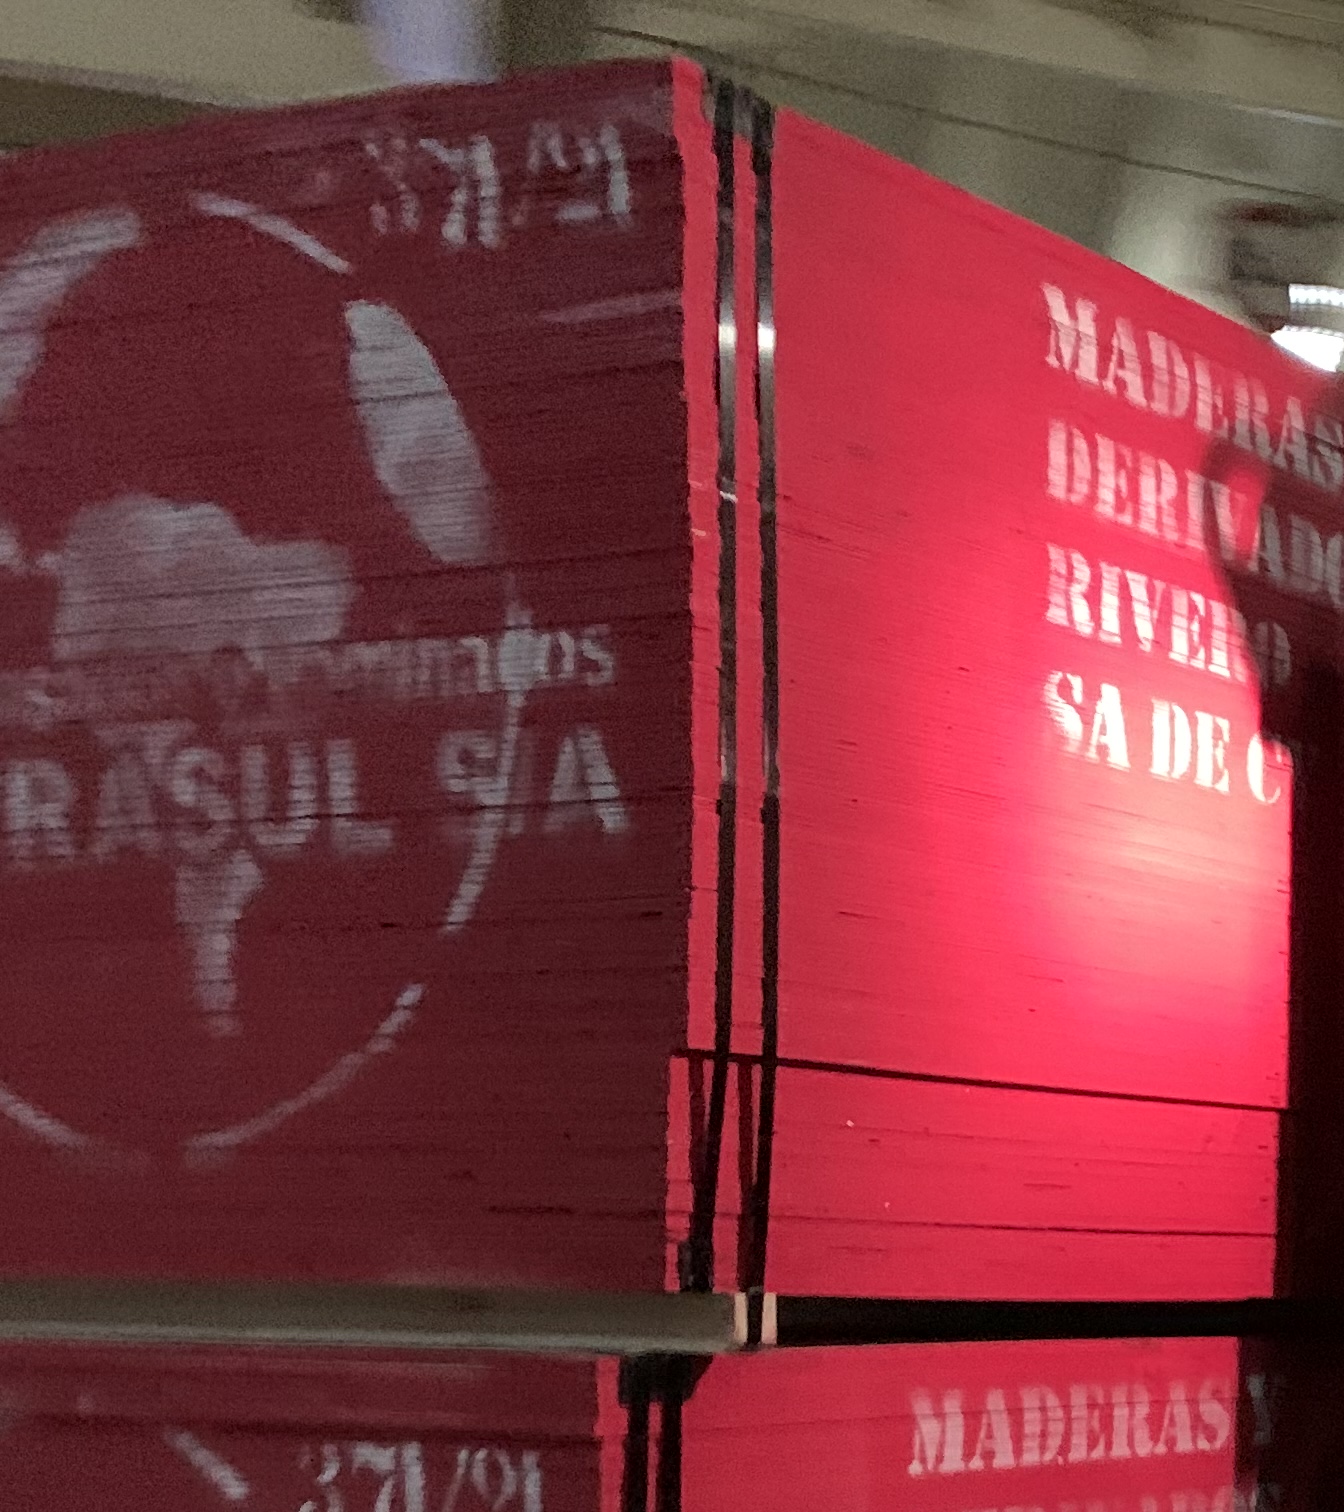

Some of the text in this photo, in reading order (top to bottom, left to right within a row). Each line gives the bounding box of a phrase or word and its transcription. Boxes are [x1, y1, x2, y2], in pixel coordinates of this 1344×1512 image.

[1044, 542, 1293, 690] RIVERO
[0, 734, 394, 866] RASUL
[1043, 668, 1284, 806] SA DE C
[907, 1377, 1232, 1478] MADERAS
